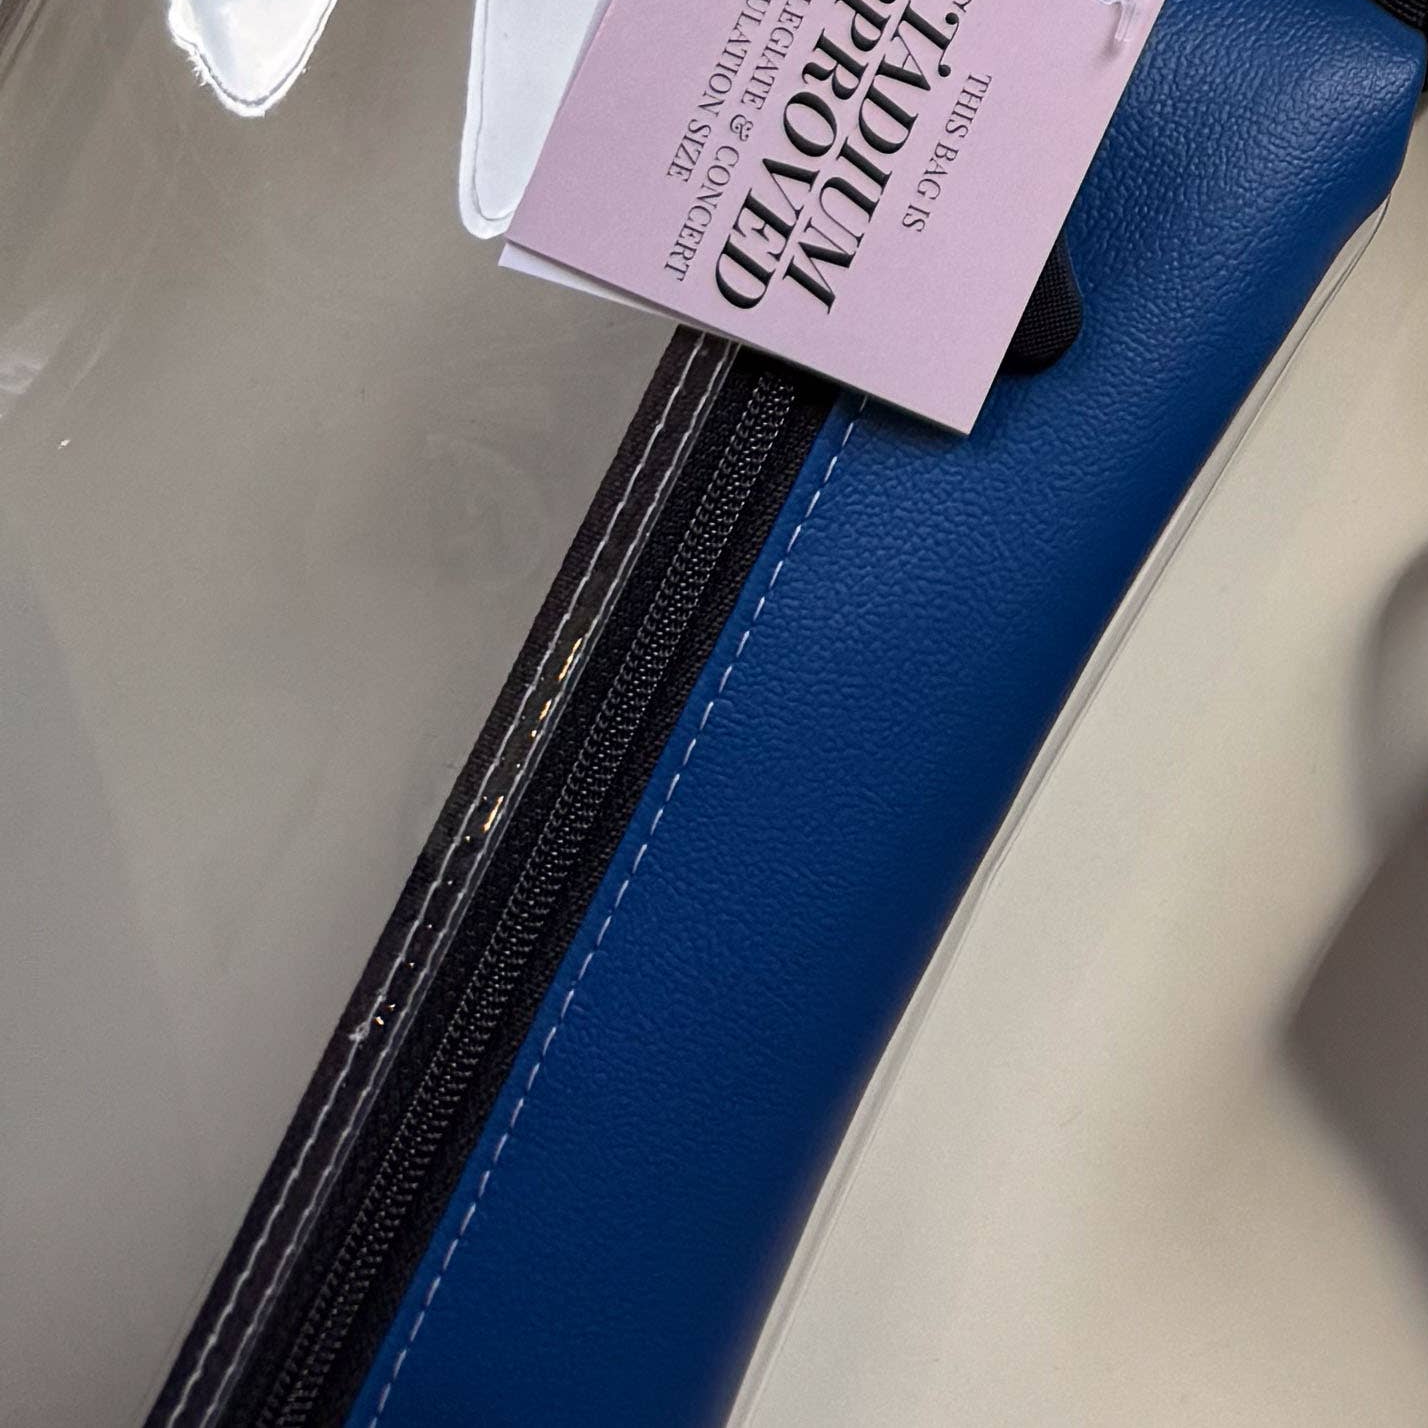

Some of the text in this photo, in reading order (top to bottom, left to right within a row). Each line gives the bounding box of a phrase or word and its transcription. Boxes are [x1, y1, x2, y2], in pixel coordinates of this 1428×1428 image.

[666, 118, 712, 183] SIZE
[729, 113, 754, 142] &
[901, 74, 993, 233] THIS BAG IS
[663, 145, 740, 282] CONCERT
